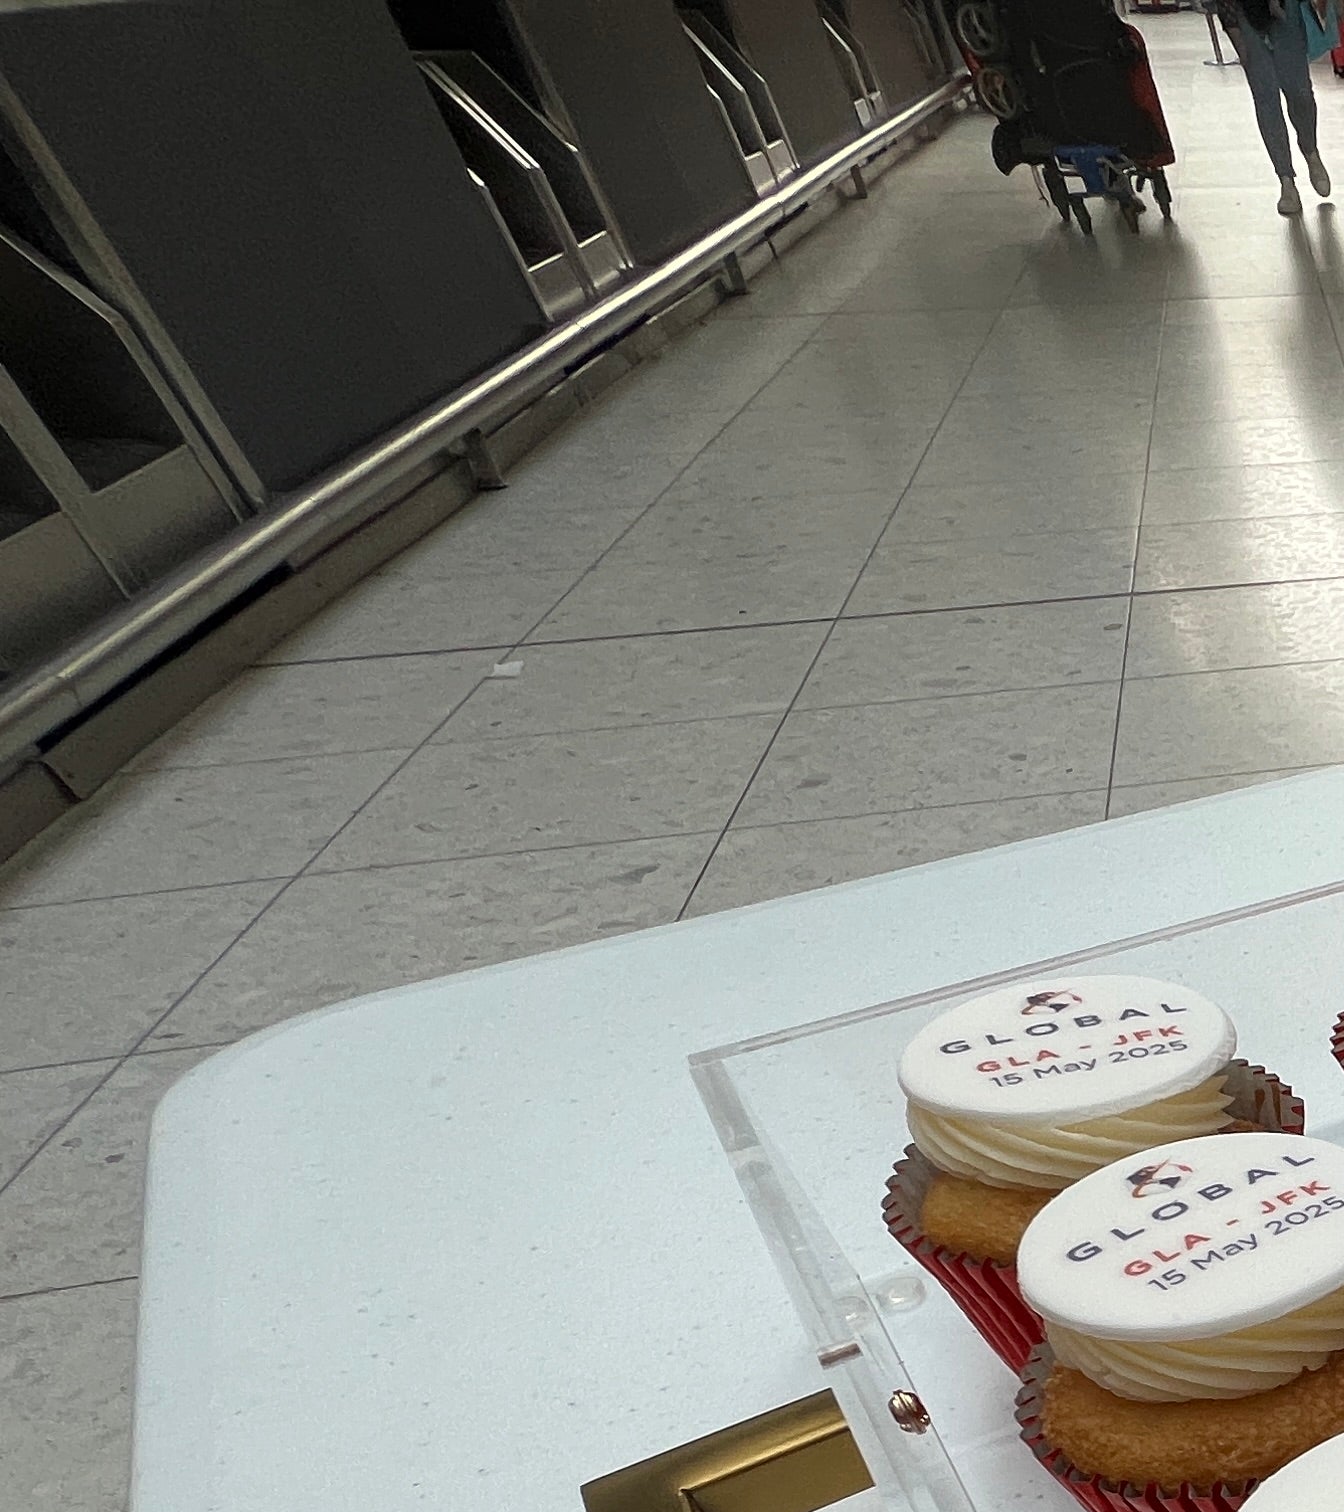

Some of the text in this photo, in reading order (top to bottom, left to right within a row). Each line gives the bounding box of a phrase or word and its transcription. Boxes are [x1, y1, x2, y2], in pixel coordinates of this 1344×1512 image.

[940, 1003, 1187, 1054] GLOBAL
[976, 1025, 1183, 1072] GLA JFK
[989, 1040, 1188, 1087] 15 May 2025
[1066, 1156, 1315, 1262] GLOBAL
[1124, 1234, 1211, 1276] GLA
[1261, 1181, 1330, 1214] JFK
[1148, 1269, 1186, 1290] 15
[1190, 1233, 1258, 1270] May
